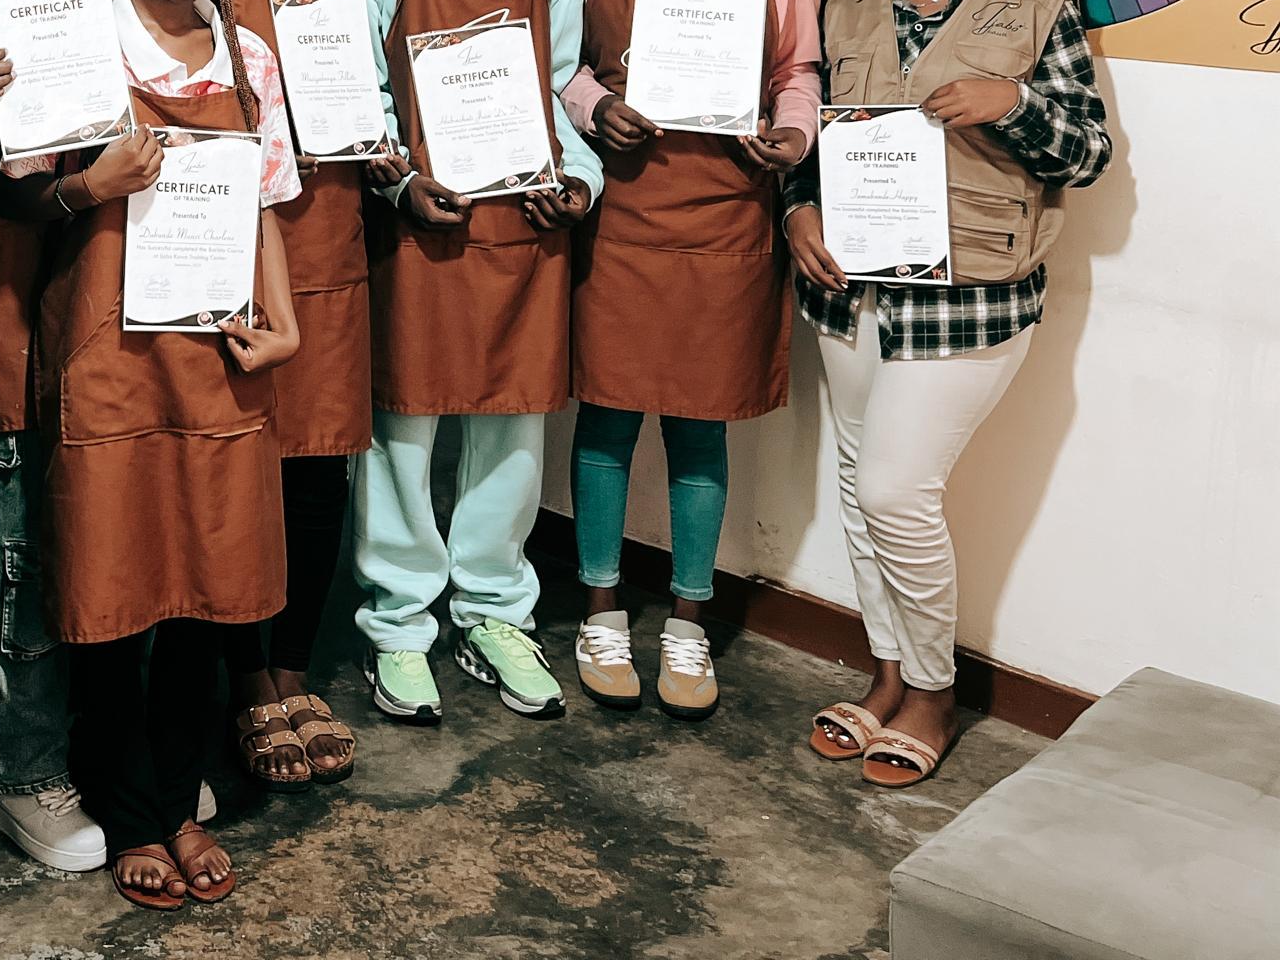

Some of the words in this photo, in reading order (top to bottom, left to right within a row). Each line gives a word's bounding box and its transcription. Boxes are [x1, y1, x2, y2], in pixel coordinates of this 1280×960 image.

[663, 8, 735, 22] CERTIFICATE
[297, 35, 351, 44] CERTIFICATE
[442, 68, 509, 85] CERTIFICATE
[846, 152, 917, 161] CERTIFICATE
[156, 182, 230, 195] CERTIFICATE
[172, 212, 199, 220] Presented
